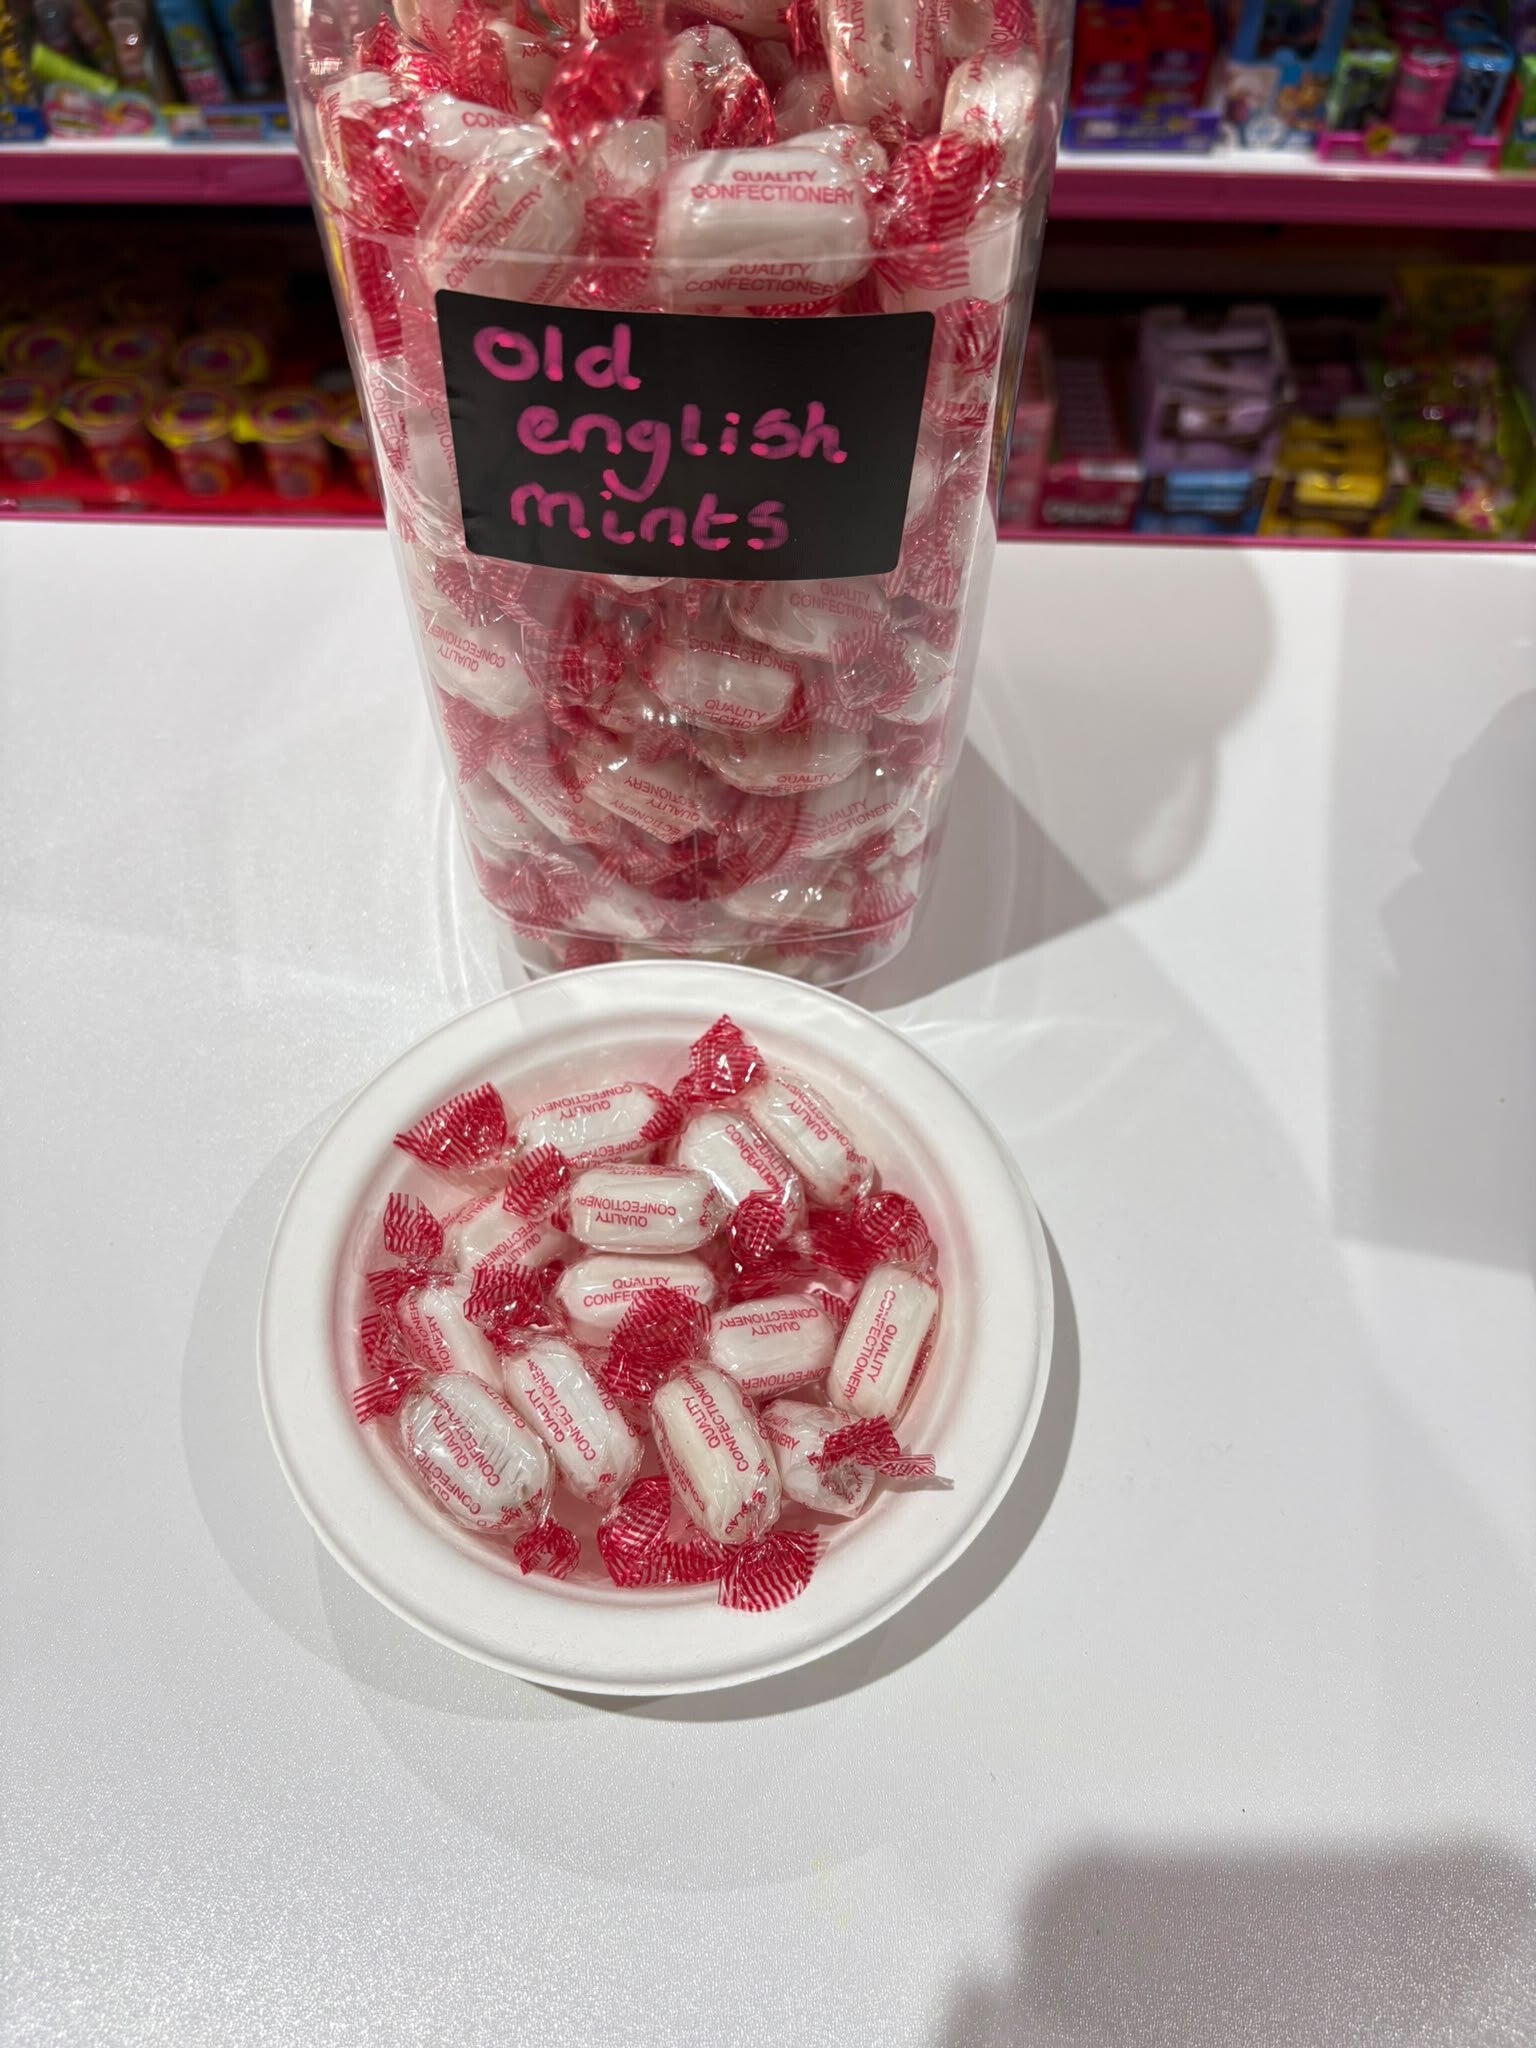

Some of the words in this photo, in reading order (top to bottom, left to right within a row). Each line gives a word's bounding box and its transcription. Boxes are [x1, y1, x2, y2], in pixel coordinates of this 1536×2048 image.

[691, 185, 854, 204] CONFECTIONERY
[732, 170, 818, 183] QUALITY
[446, 184, 543, 288] CONFECTIONERY
[450, 195, 502, 252] QUALITY
[729, 263, 811, 276] QUALITY
[473, 323, 642, 391] Old
[516, 401, 847, 503] english
[510, 482, 789, 551] mints
[789, 592, 886, 625] CONFECTIONER
[821, 582, 871, 604] QUALITY
[427, 624, 506, 669] CONFECTIONER
[437, 644, 479, 673] QUALITY
[688, 637, 800, 673] CONFECTIONER
[704, 699, 767, 721] QUALITY
[624, 774, 697, 807] ECTIONERY
[777, 773, 836, 783] QUALITY
[610, 800, 681, 836] ECTIONERY
[646, 799, 701, 823] QUALITY
[815, 797, 869, 829] QUALITY
[818, 798, 900, 842] NFECTIONERY
[530, 1084, 633, 1120] CONFECTIONERY
[559, 1100, 612, 1121] QUALITY
[786, 1100, 829, 1142] QUALITY
[752, 1138, 790, 1183] QUALITY
[595, 1211, 648, 1228] QUALITY
[612, 1276, 671, 1290] QUALITY
[719, 1308, 819, 1330] CONFECTIONERY
[751, 1321, 801, 1336] QUALITY
[843, 1289, 897, 1404] CONFECTIONERY
[867, 1324, 898, 1384] QUALITY
[480, 1383, 527, 1430] QUALITY
[525, 1389, 566, 1443] QUALITY
[682, 1396, 722, 1449] QUALITY
[432, 1413, 470, 1469] QUALITY
